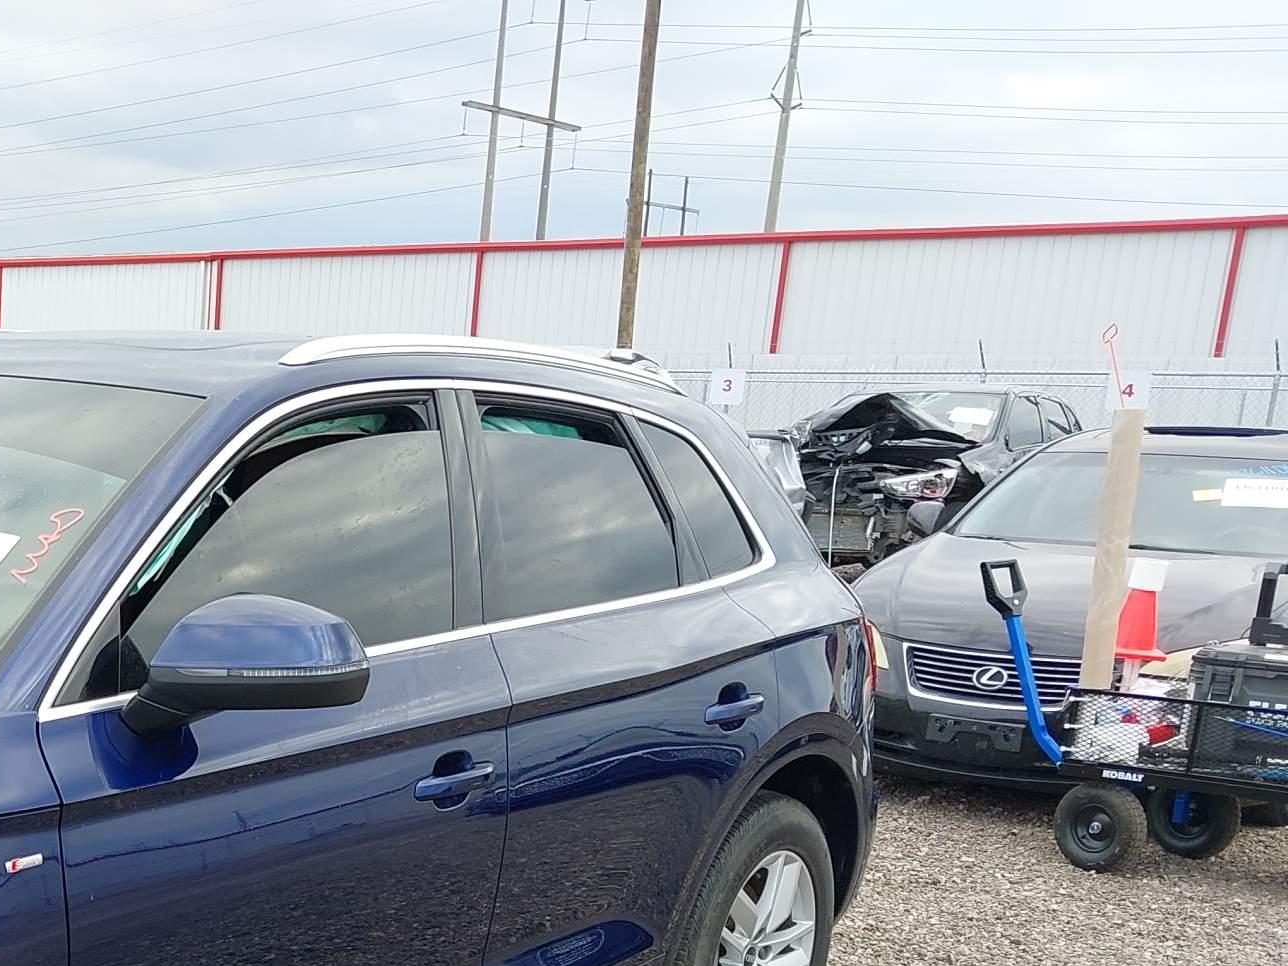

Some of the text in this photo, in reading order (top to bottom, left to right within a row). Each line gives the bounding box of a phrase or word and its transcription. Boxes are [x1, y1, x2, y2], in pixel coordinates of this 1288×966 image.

[722, 379, 732, 392] 3
[1122, 383, 1135, 398] 4
[1102, 769, 1144, 783] KOBALT
